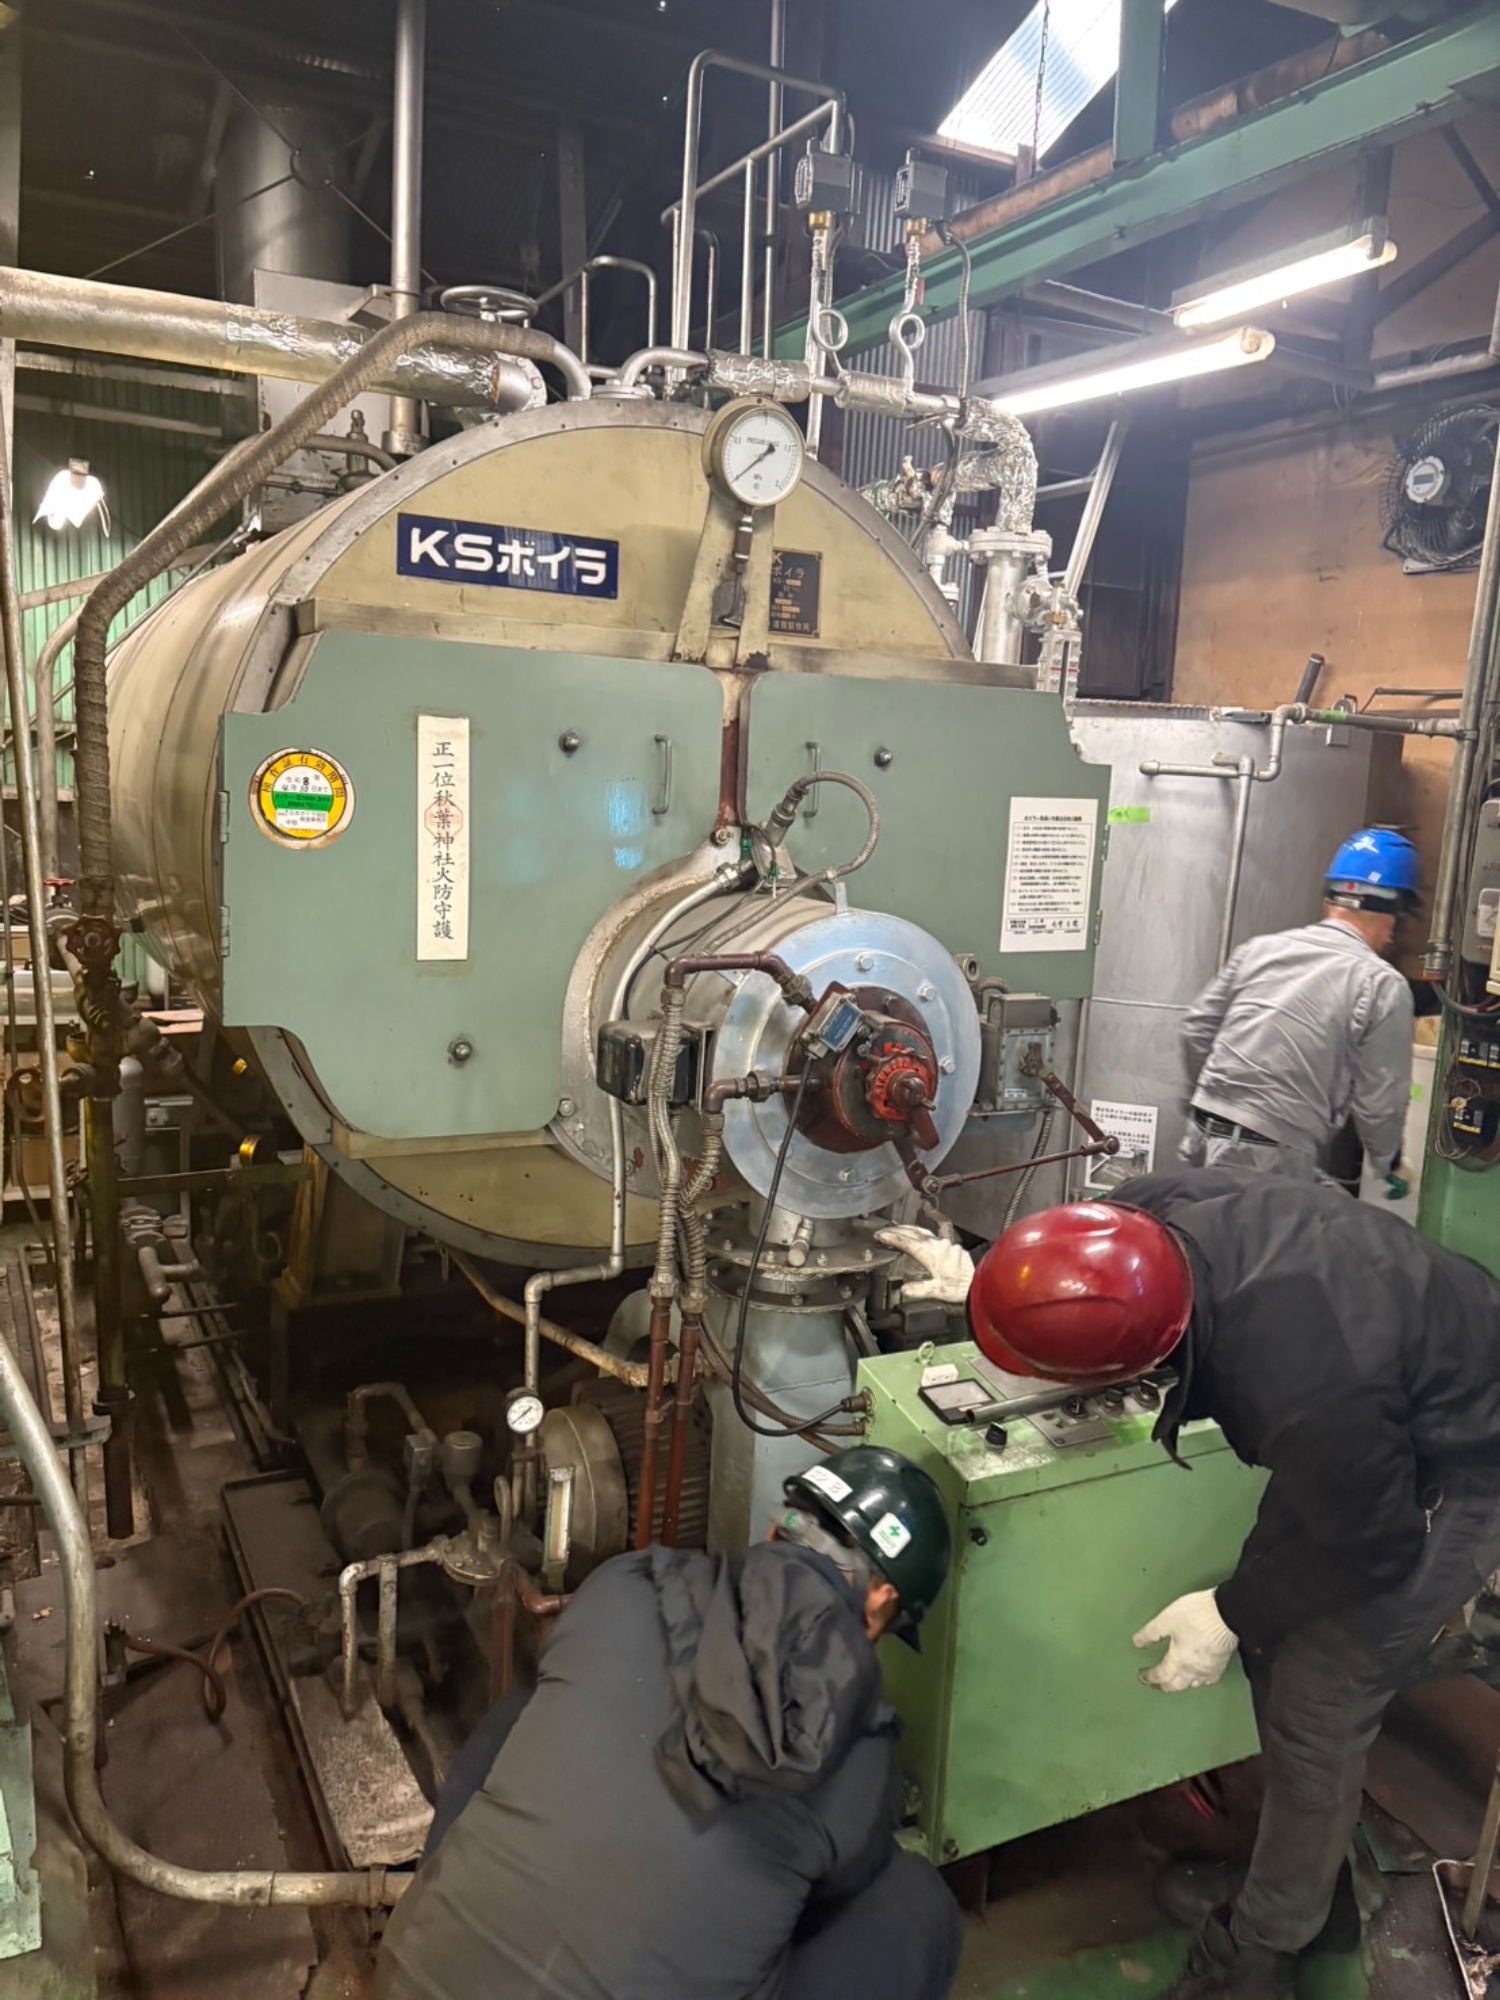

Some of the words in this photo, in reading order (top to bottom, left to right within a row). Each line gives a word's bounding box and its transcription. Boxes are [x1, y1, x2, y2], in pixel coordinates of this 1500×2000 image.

[410, 526, 607, 586] KSボイラ
[431, 741, 456, 941] 正一位秋葉神社火防守護
